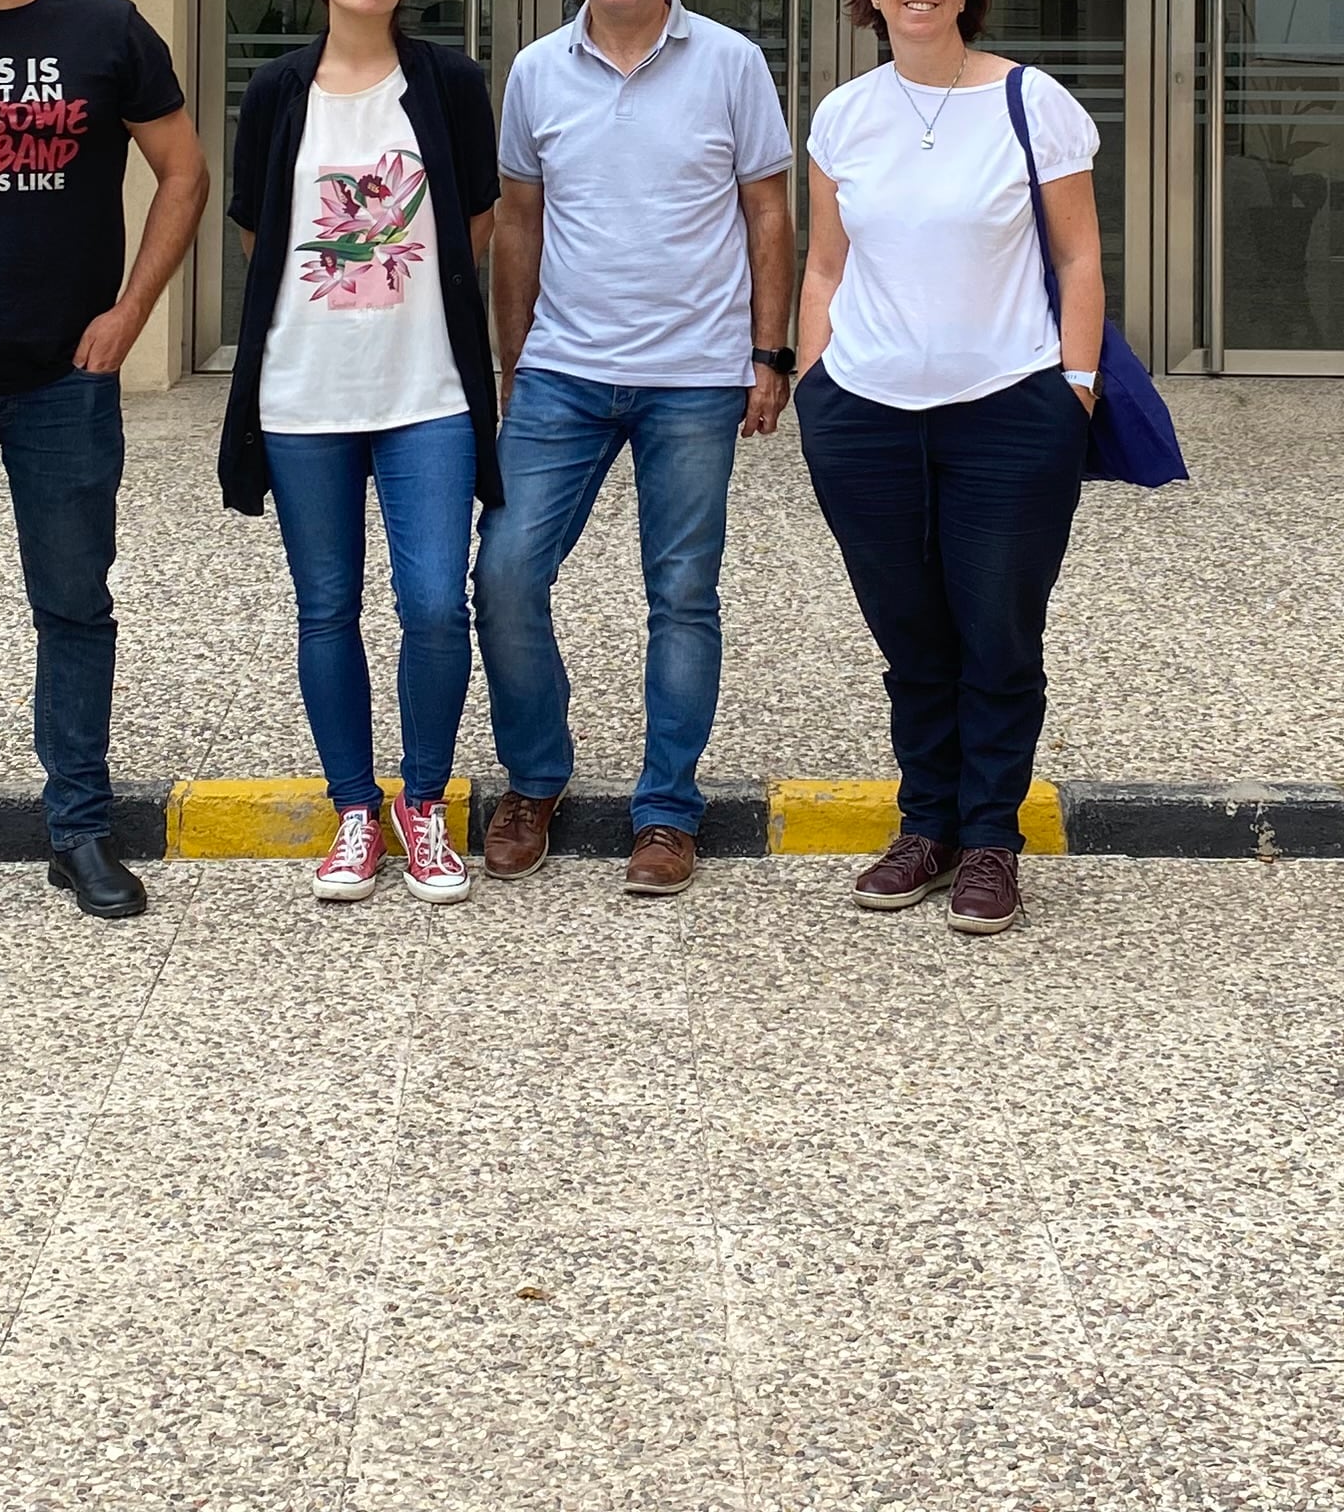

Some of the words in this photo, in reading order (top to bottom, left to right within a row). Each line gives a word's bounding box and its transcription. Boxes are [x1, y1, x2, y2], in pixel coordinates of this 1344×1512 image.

[27, 57, 60, 83] IS
[20, 83, 63, 102] AN
[17, 172, 65, 192] LIKE
